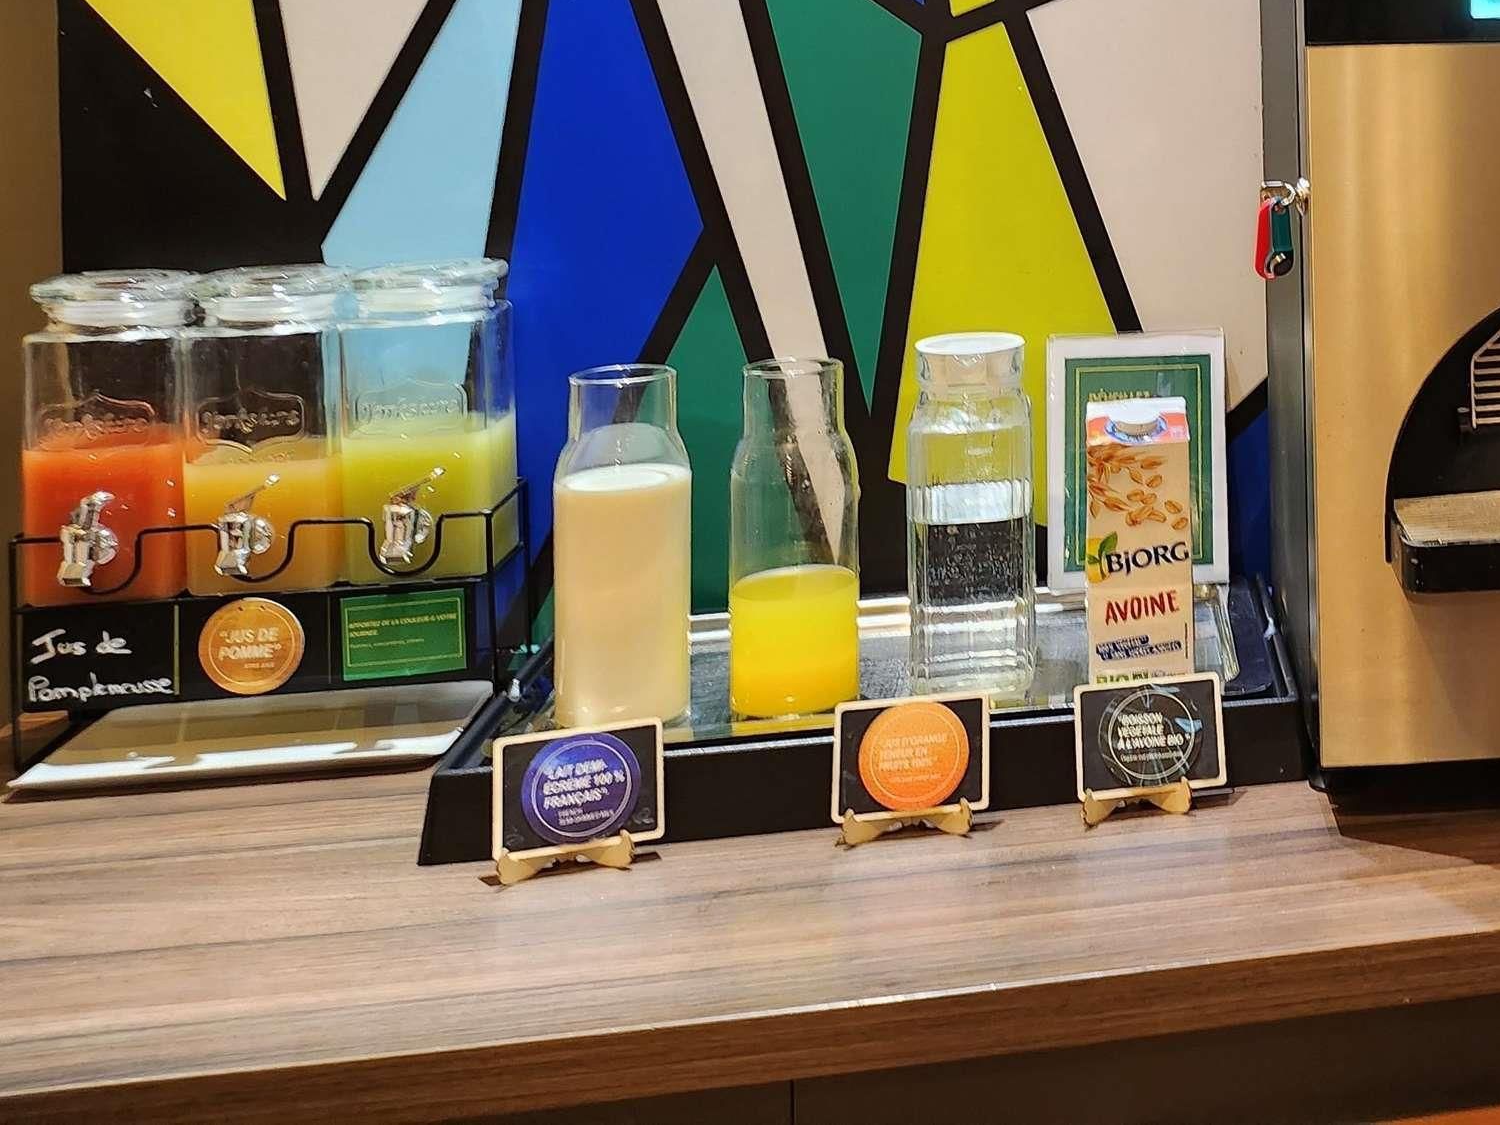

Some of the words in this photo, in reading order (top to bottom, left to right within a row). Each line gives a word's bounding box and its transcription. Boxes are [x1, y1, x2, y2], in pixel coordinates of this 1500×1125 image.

[1105, 589, 1181, 626] AVOINE
[30, 628, 88, 665] Jus
[95, 630, 133, 655] de
[258, 626, 280, 642] DE
